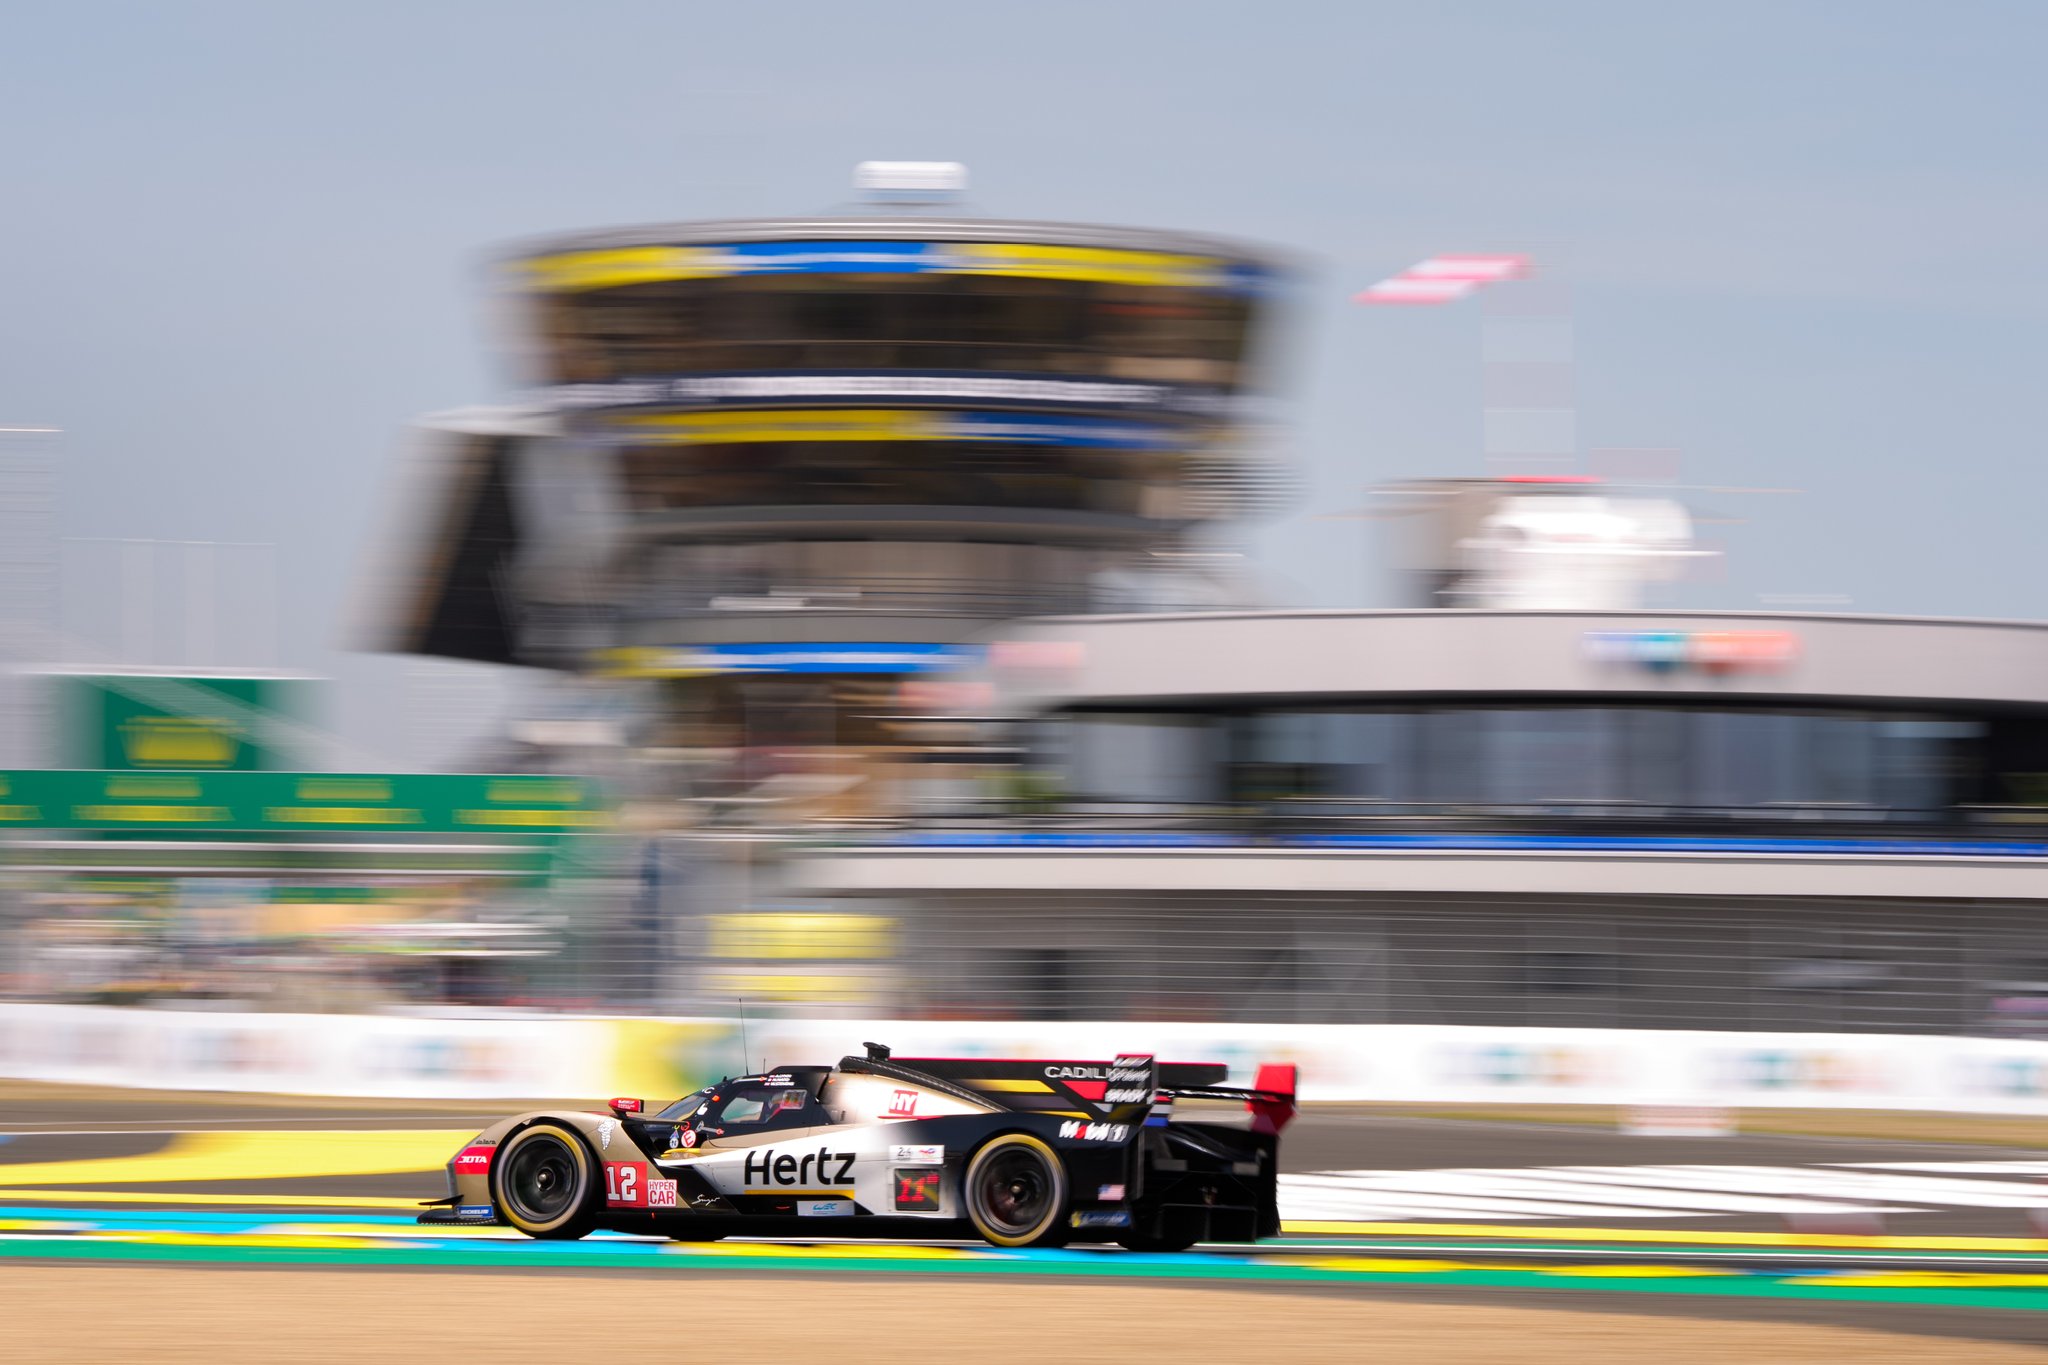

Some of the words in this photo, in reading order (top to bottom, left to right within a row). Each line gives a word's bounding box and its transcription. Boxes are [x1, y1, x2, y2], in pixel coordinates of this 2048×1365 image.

[890, 1092, 917, 1113] HY
[1059, 1121, 1111, 1140] Mobil
[458, 1156, 487, 1164] JOTA
[744, 1147, 856, 1185] Hertz
[606, 1166, 637, 1201] 12
[649, 1181, 675, 1190] HYPER
[649, 1190, 675, 1205] CAR
[813, 1203, 837, 1211] WEC
